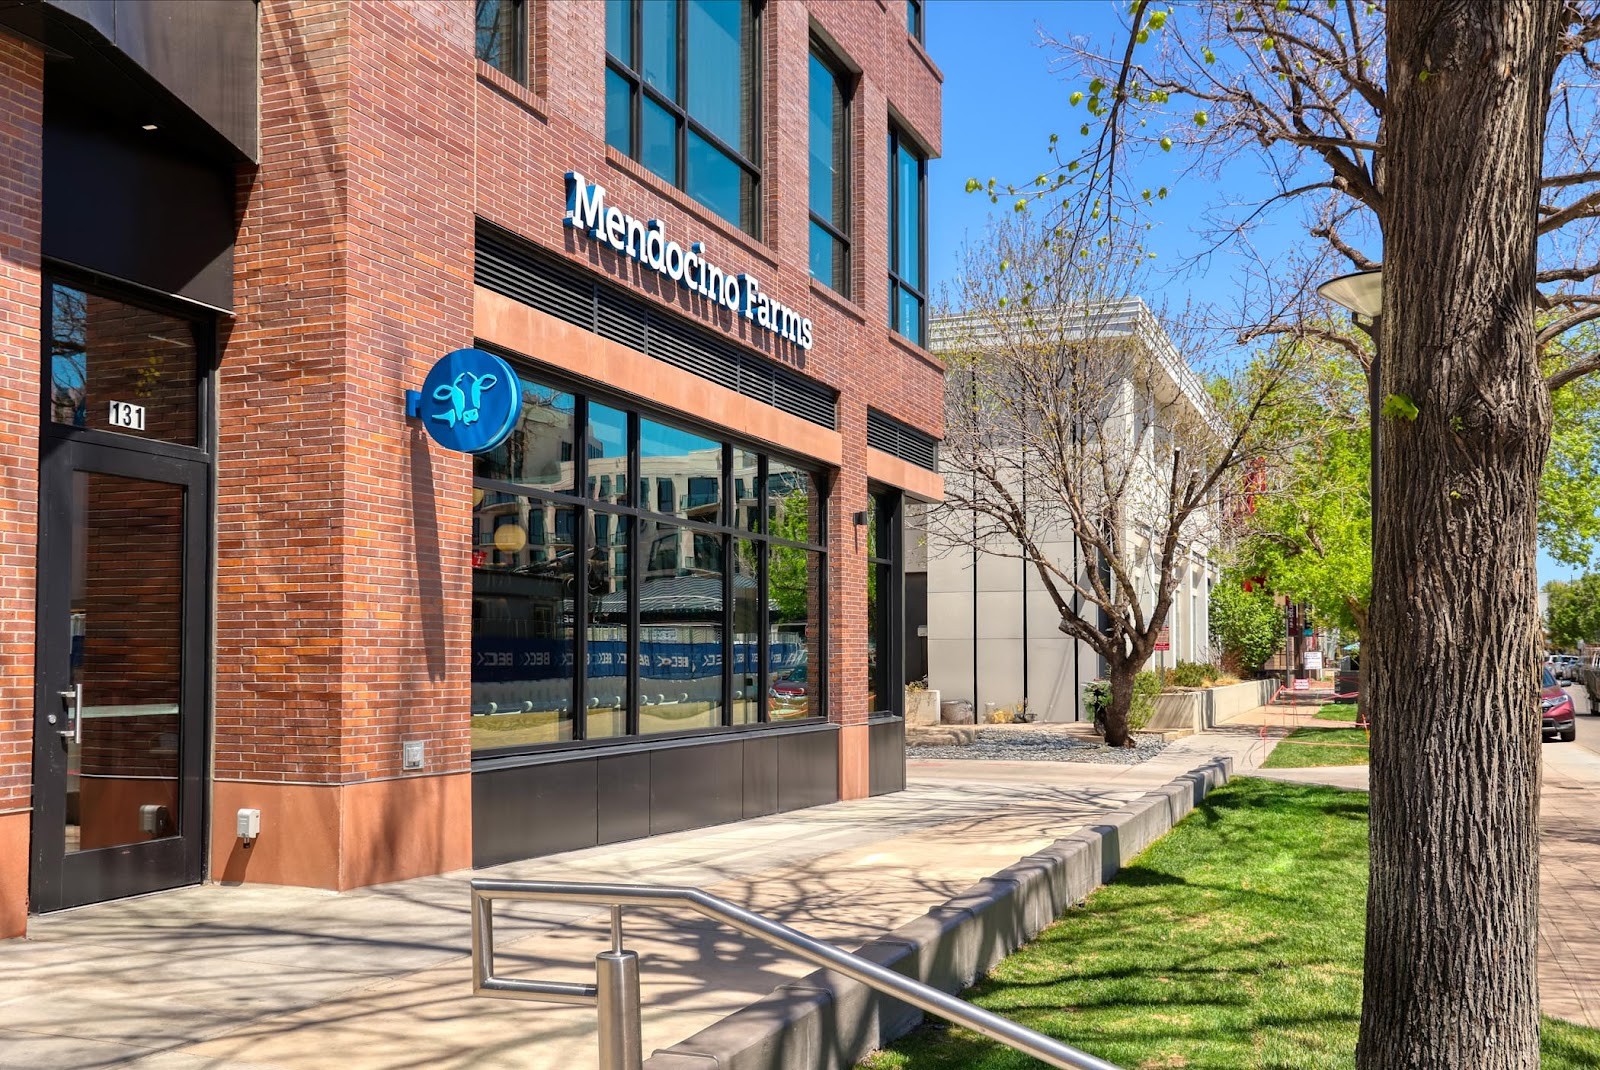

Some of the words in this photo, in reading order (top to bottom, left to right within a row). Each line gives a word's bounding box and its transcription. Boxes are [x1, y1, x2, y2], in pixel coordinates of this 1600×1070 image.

[563, 171, 740, 312] Mendocino
[739, 273, 813, 350] Farms
[112, 402, 142, 429] 131
